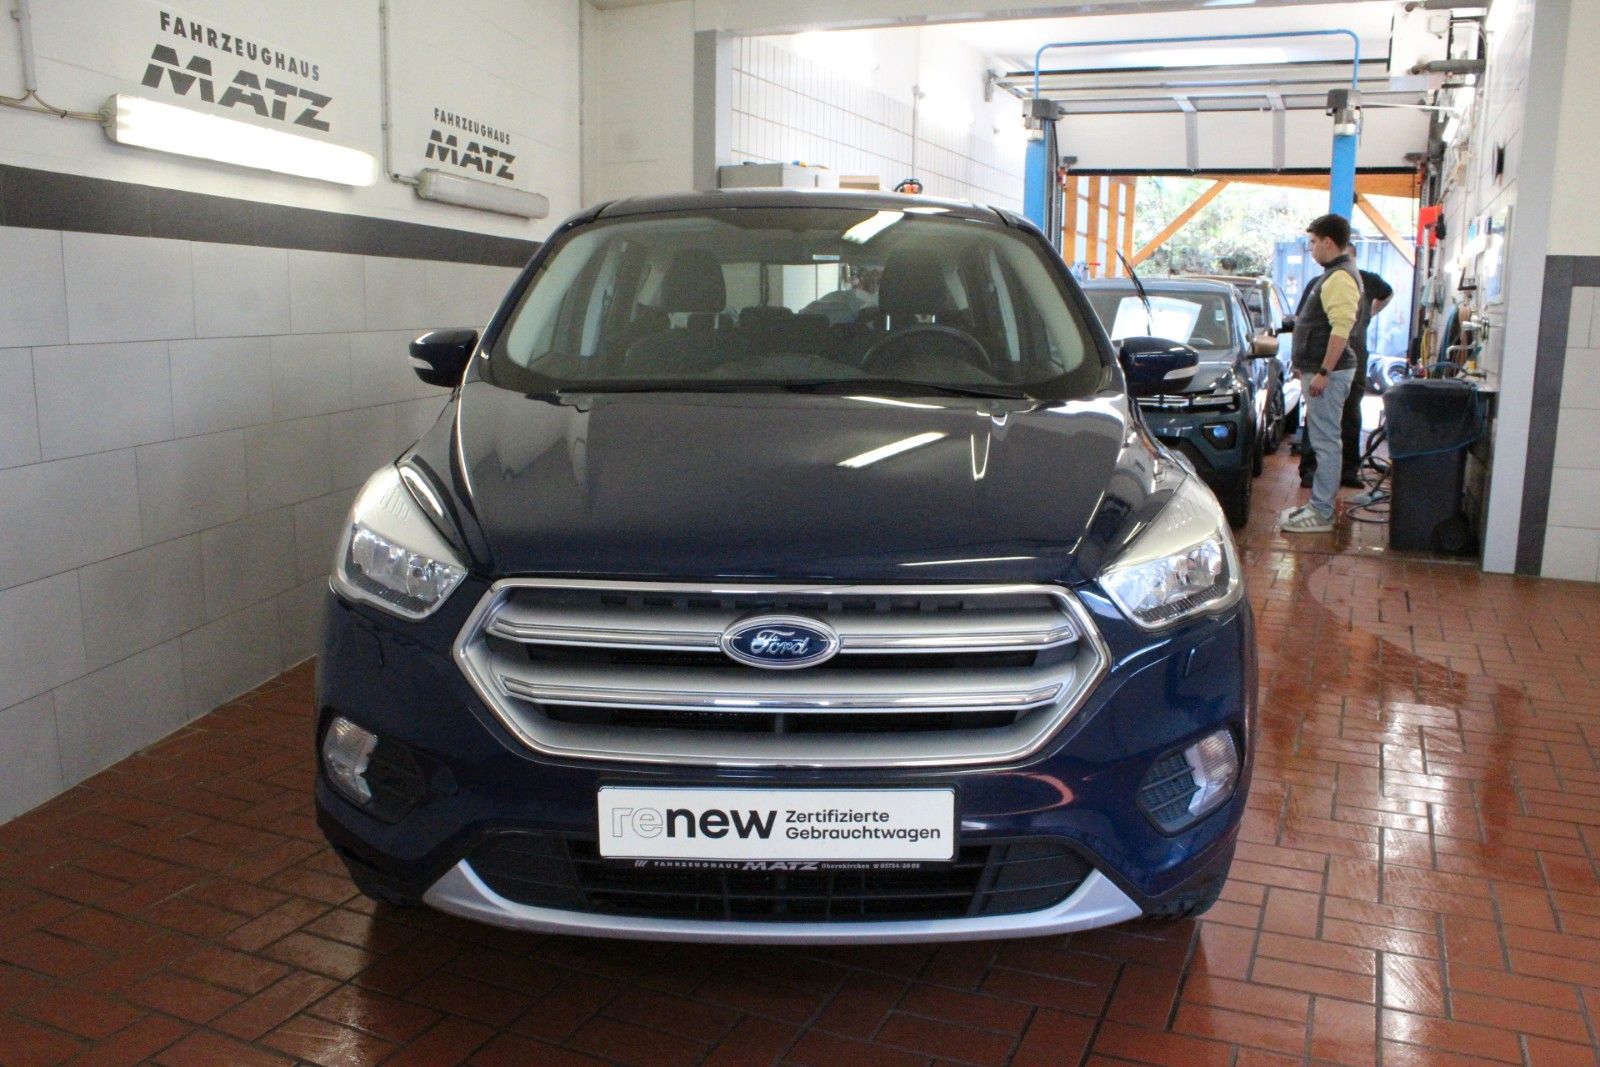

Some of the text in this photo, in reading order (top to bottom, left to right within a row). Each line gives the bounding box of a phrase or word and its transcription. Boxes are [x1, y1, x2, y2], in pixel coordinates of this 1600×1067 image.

[159, 10, 321, 82] FAHRZEUGHAUS
[141, 43, 332, 132] MATZ
[433, 107, 511, 145] FAHRZEUGHAUS
[425, 129, 516, 181] MATZ
[750, 629, 810, 655] Ford
[611, 807, 778, 839] renew
[785, 808, 890, 824] Zertifizierte
[785, 825, 941, 843] Gebrauchtwagen
[654, 861, 739, 869] FAHRZEUGHAUS
[741, 861, 820, 871] MATZ
